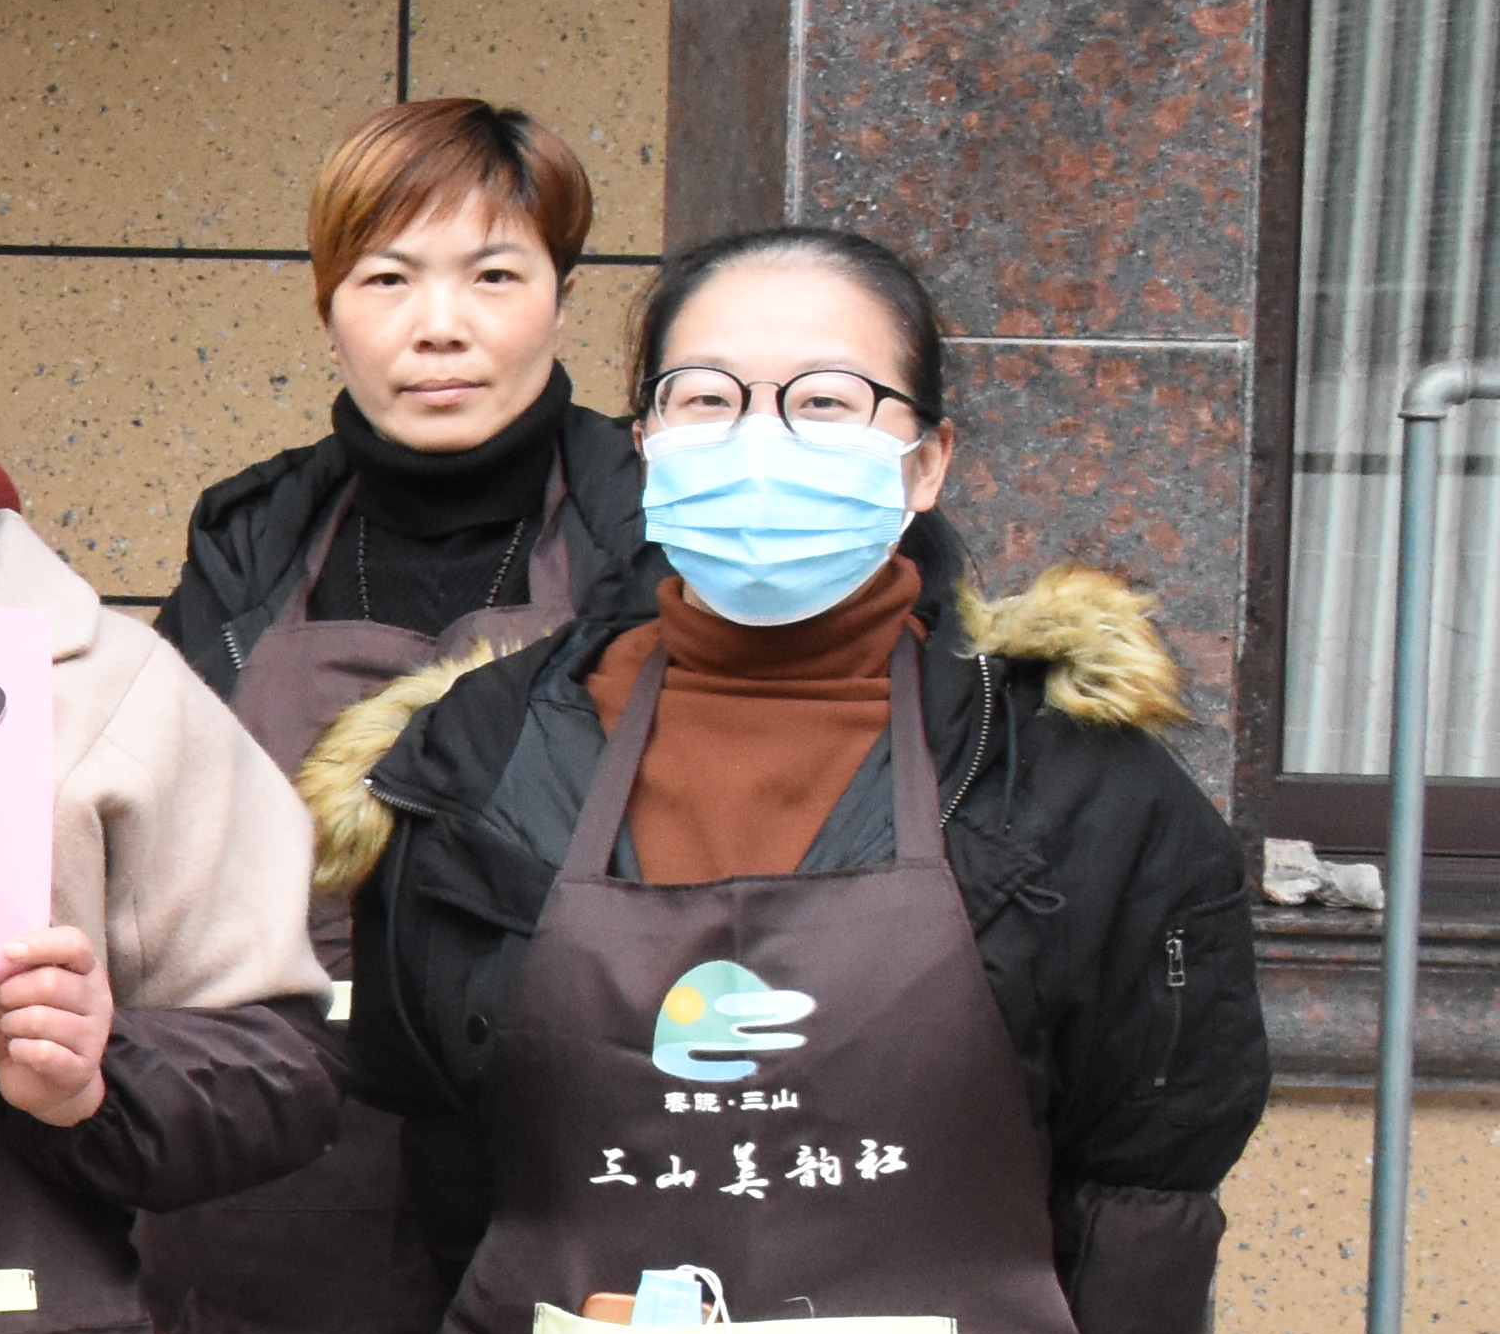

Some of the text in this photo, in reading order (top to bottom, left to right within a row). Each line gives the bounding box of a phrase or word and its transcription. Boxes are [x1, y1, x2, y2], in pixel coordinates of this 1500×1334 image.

[589, 1139, 908, 1199] 三山美韵社
